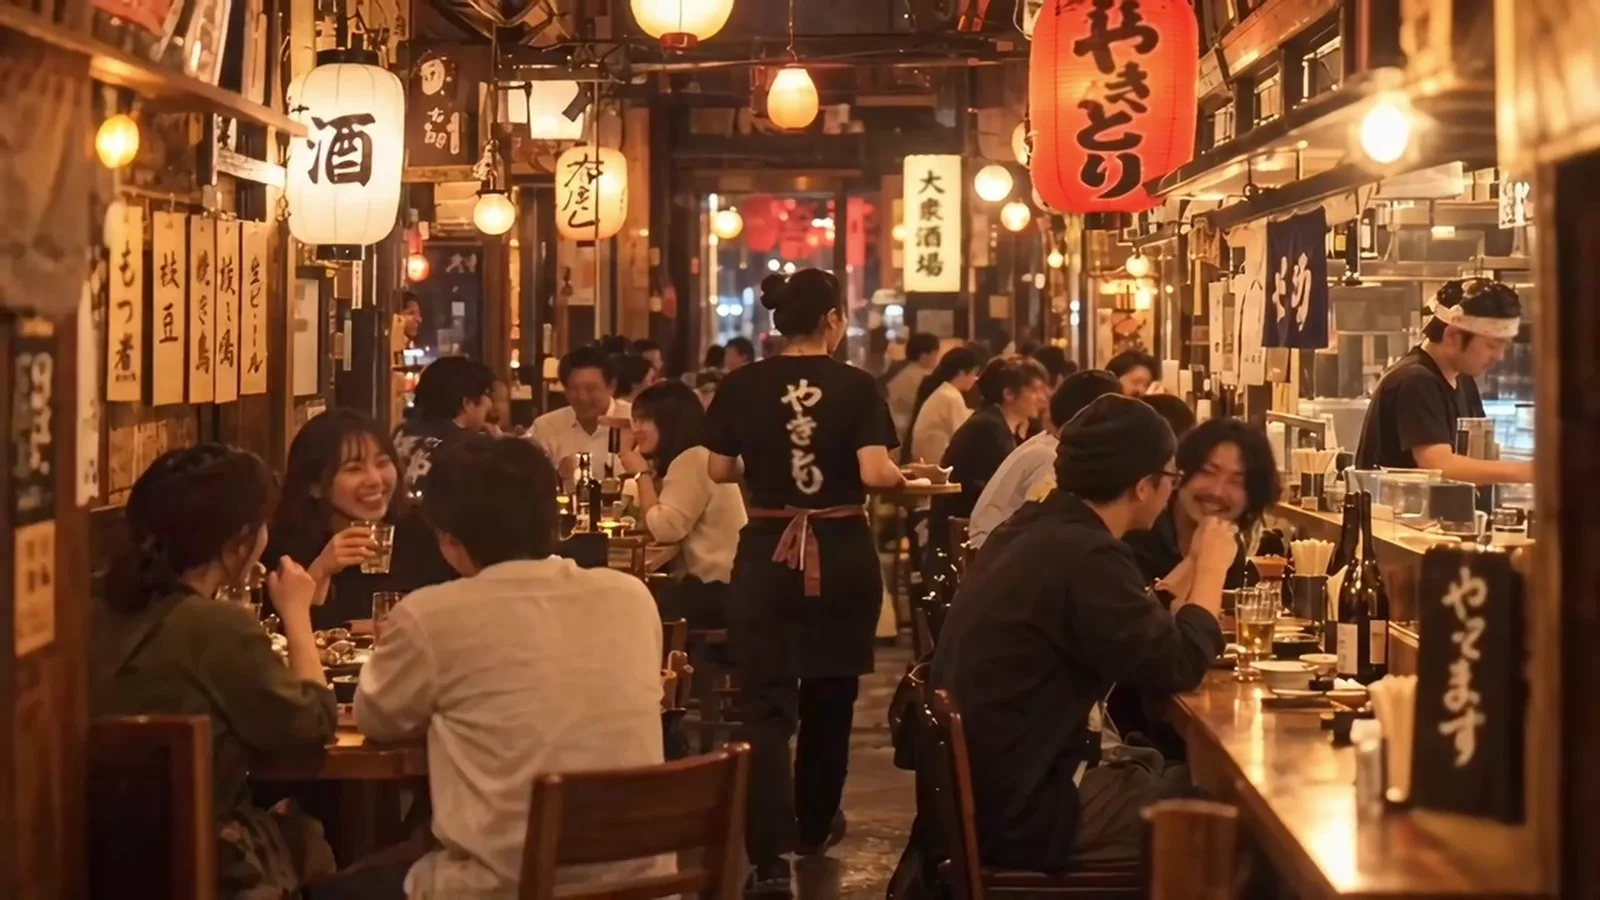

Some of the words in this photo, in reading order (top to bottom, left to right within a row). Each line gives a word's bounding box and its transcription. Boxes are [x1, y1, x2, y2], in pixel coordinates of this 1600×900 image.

[306, 112, 377, 188] 酒
[1073, 0, 1160, 199] やきとり
[915, 168, 945, 278] 大衆酒場
[158, 250, 181, 345] 枝豆
